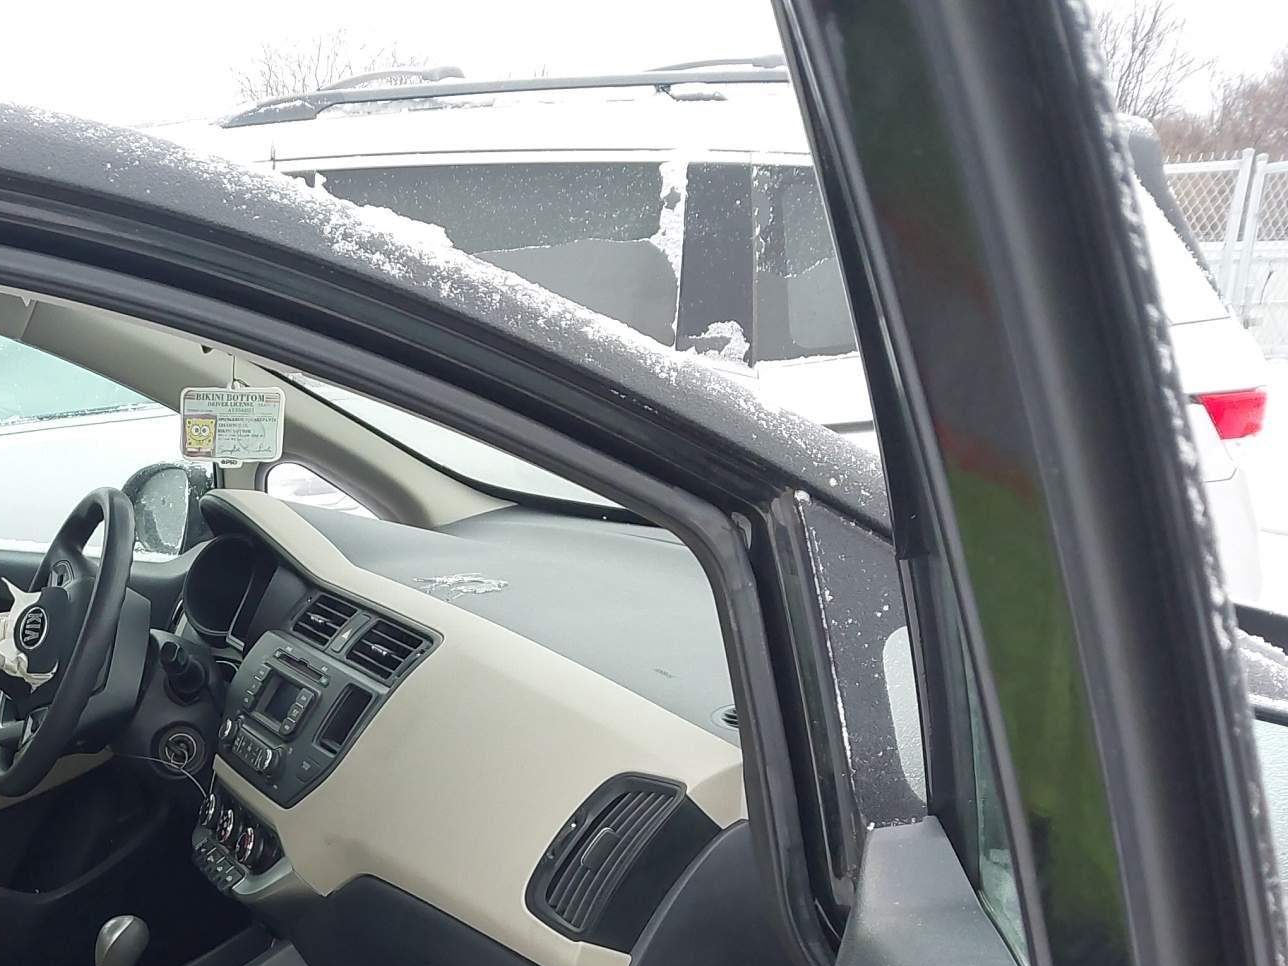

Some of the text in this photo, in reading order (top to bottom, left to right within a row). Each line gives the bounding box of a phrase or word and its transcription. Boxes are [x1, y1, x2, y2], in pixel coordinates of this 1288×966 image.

[196, 393, 265, 402] BIKINI BOTTOM
[23, 612, 43, 642] KIA
